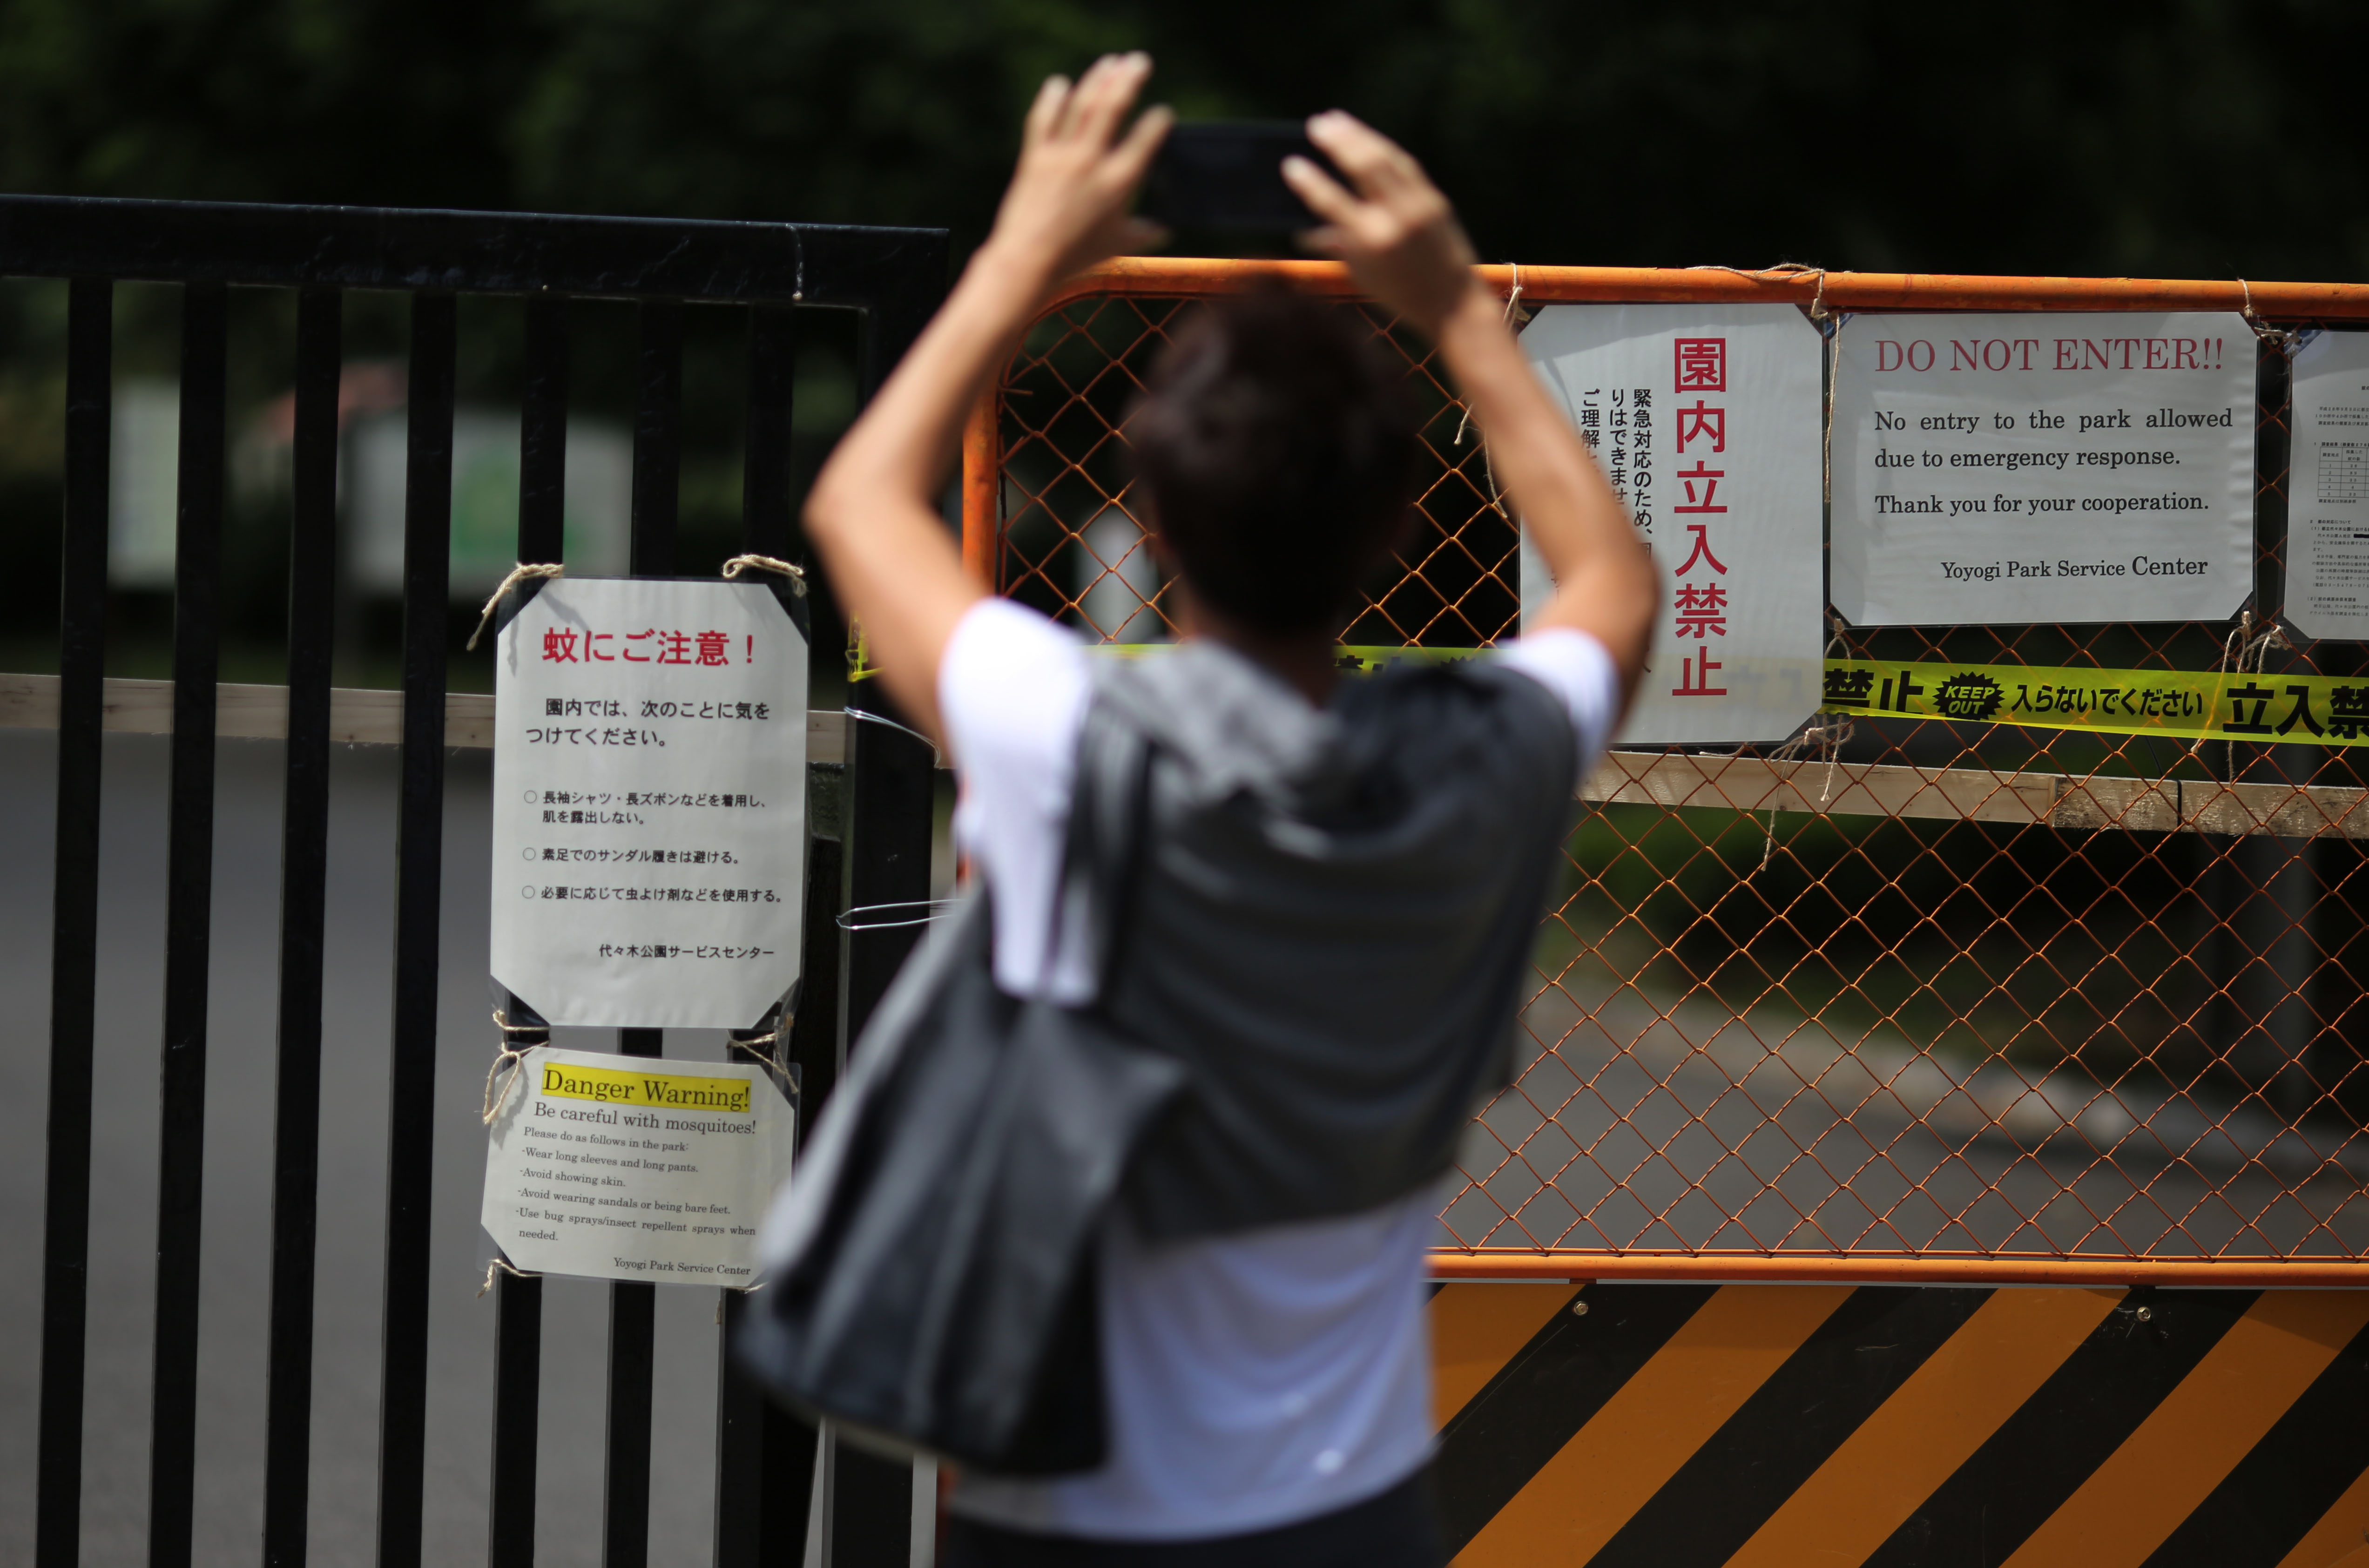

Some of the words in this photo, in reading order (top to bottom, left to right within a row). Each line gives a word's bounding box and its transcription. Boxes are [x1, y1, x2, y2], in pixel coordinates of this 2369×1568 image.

[1875, 339, 1936, 372] DO
[1950, 339, 2039, 372] NOT
[2052, 338, 2222, 370] ENTER!!
[1875, 411, 1906, 431] No
[1920, 412, 1980, 434] entry
[1993, 412, 2015, 429] to
[2029, 409, 2065, 429] the
[2079, 408, 2132, 433] park
[2146, 408, 2233, 428] allowed
[1875, 448, 1915, 467] due
[1921, 450, 1943, 467] to
[1950, 453, 2070, 471] emergency
[2076, 451, 2180, 469] response.
[1673, 337, 1728, 697] 園内立入禁止
[1875, 494, 1944, 514] Thank
[1950, 500, 1987, 517] you
[1993, 493, 2022, 512] for
[2028, 499, 2076, 516] your
[2082, 492, 2208, 514] cooperation.
[1940, 561, 2001, 582] Yoyogi
[2006, 561, 2052, 577] Park
[2058, 560, 2125, 577] Service
[2132, 556, 2208, 576] Center
[542, 627, 754, 666] 蚊にご注意！
[1945, 686, 1996, 698] KEEP
[2011, 683, 2202, 717] 入らないでください
[546, 698, 770, 720] 園内では、次のことに気を
[1948, 700, 1985, 715] OUT
[2222, 682, 2369, 739] 立入禁
[526, 727, 666, 747] つけてください。
[542, 791, 766, 808] 長袖シャツ・長ズボンなどを着用し、
[542, 810, 645, 825] 肌を露出しない。
[542, 848, 739, 865] 素足でのサンダル履きは避ける。
[540, 886, 782, 903] 必要に応じて虫よけ剤などを使用する。
[599, 944, 774, 960] 代々木公園サービスセンター
[542, 1069, 635, 1101] Danger
[643, 1079, 750, 1111] Warning!
[534, 1102, 555, 1118] Be
[560, 1108, 617, 1125] careful
[623, 1113, 660, 1129] with
[665, 1118, 756, 1135] mosquitoes!
[524, 1126, 557, 1139] Please
[560, 1131, 573, 1141] do
[590, 1134, 626, 1147] follows
[642, 1139, 659, 1149] the
[661, 1142, 688, 1152] park:
[522, 1147, 553, 1159] -Wear
[555, 1150, 578, 1164] long
[580, 1153, 617, 1166] sleeves
[620, 1158, 640, 1168] and
[642, 1159, 666, 1172] long
[667, 1164, 698, 1173] pants.
[520, 1167, 552, 1179] -Avoid
[555, 1171, 599, 1186] showing
[601, 1176, 626, 1187] skin.
[517, 1188, 550, 1199] -Avoid
[553, 1193, 596, 1206] wearing
[598, 1197, 638, 1208] sandals
[654, 1200, 682, 1213] being
[685, 1203, 707, 1213] bare
[709, 1203, 730, 1214] feet.
[515, 1207, 539, 1218] -Use
[544, 1210, 564, 1223] bug
[568, 1216, 636, 1228] sprays/insect
[641, 1221, 687, 1232] repellent
[692, 1226, 725, 1236] sprays
[729, 1225, 756, 1235] when
[519, 1230, 558, 1241] needed.
[613, 1257, 646, 1271] Yoyogi
[650, 1260, 675, 1271] Park
[677, 1262, 714, 1273] Service
[716, 1264, 751, 1275] Center
